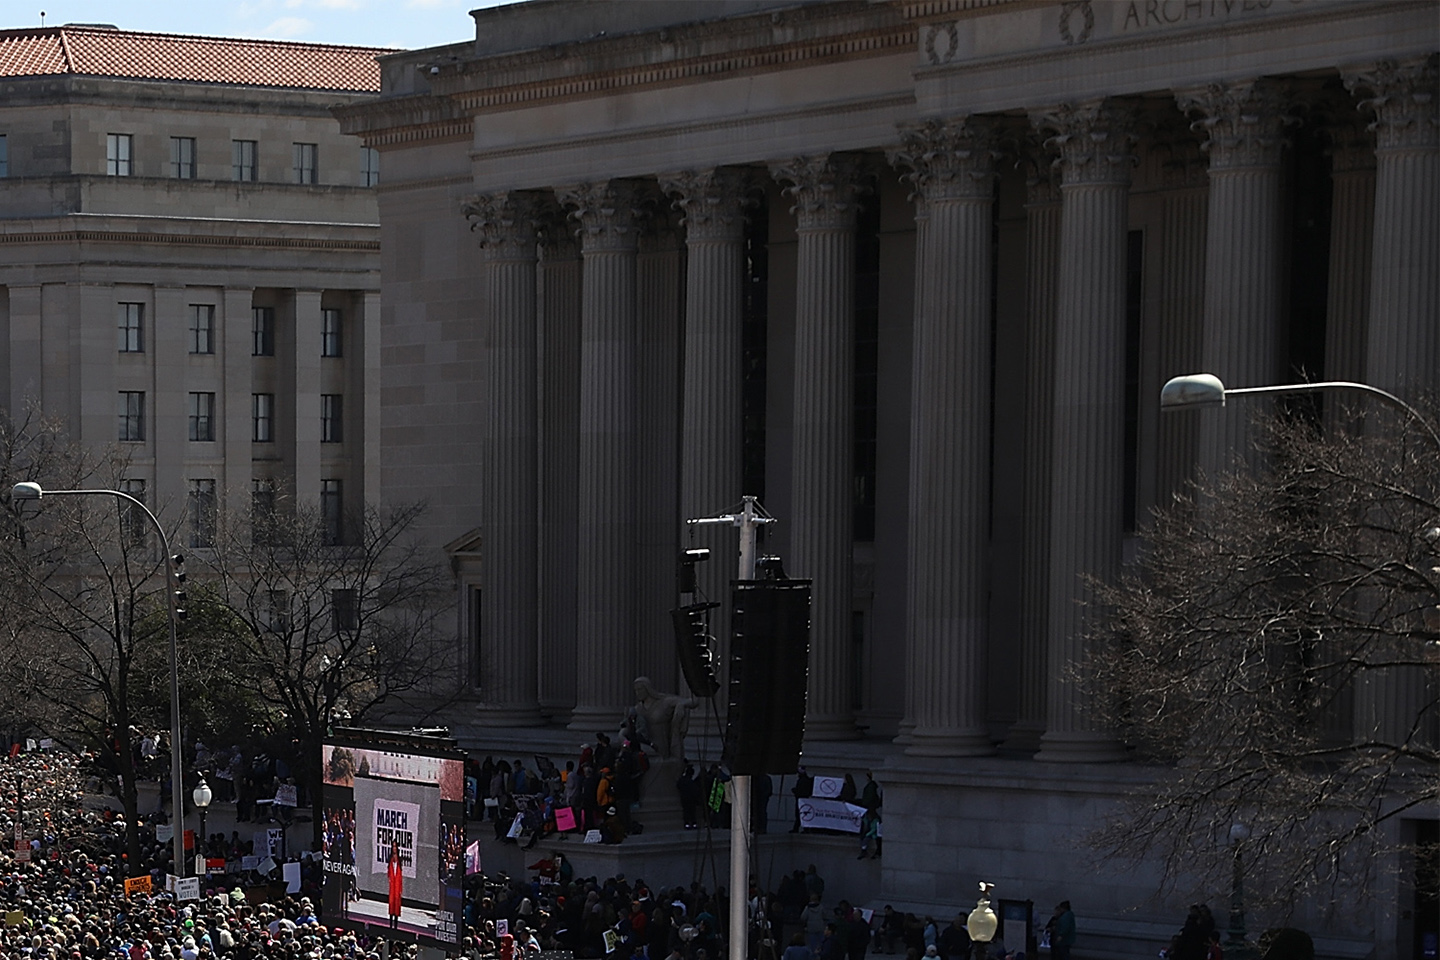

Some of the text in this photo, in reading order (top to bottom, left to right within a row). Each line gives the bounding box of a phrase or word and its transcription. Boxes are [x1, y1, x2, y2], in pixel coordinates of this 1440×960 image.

[377, 808, 408, 830] MARCH
[377, 826, 413, 850] FOR OUR
[322, 859, 342, 873] NEVER
